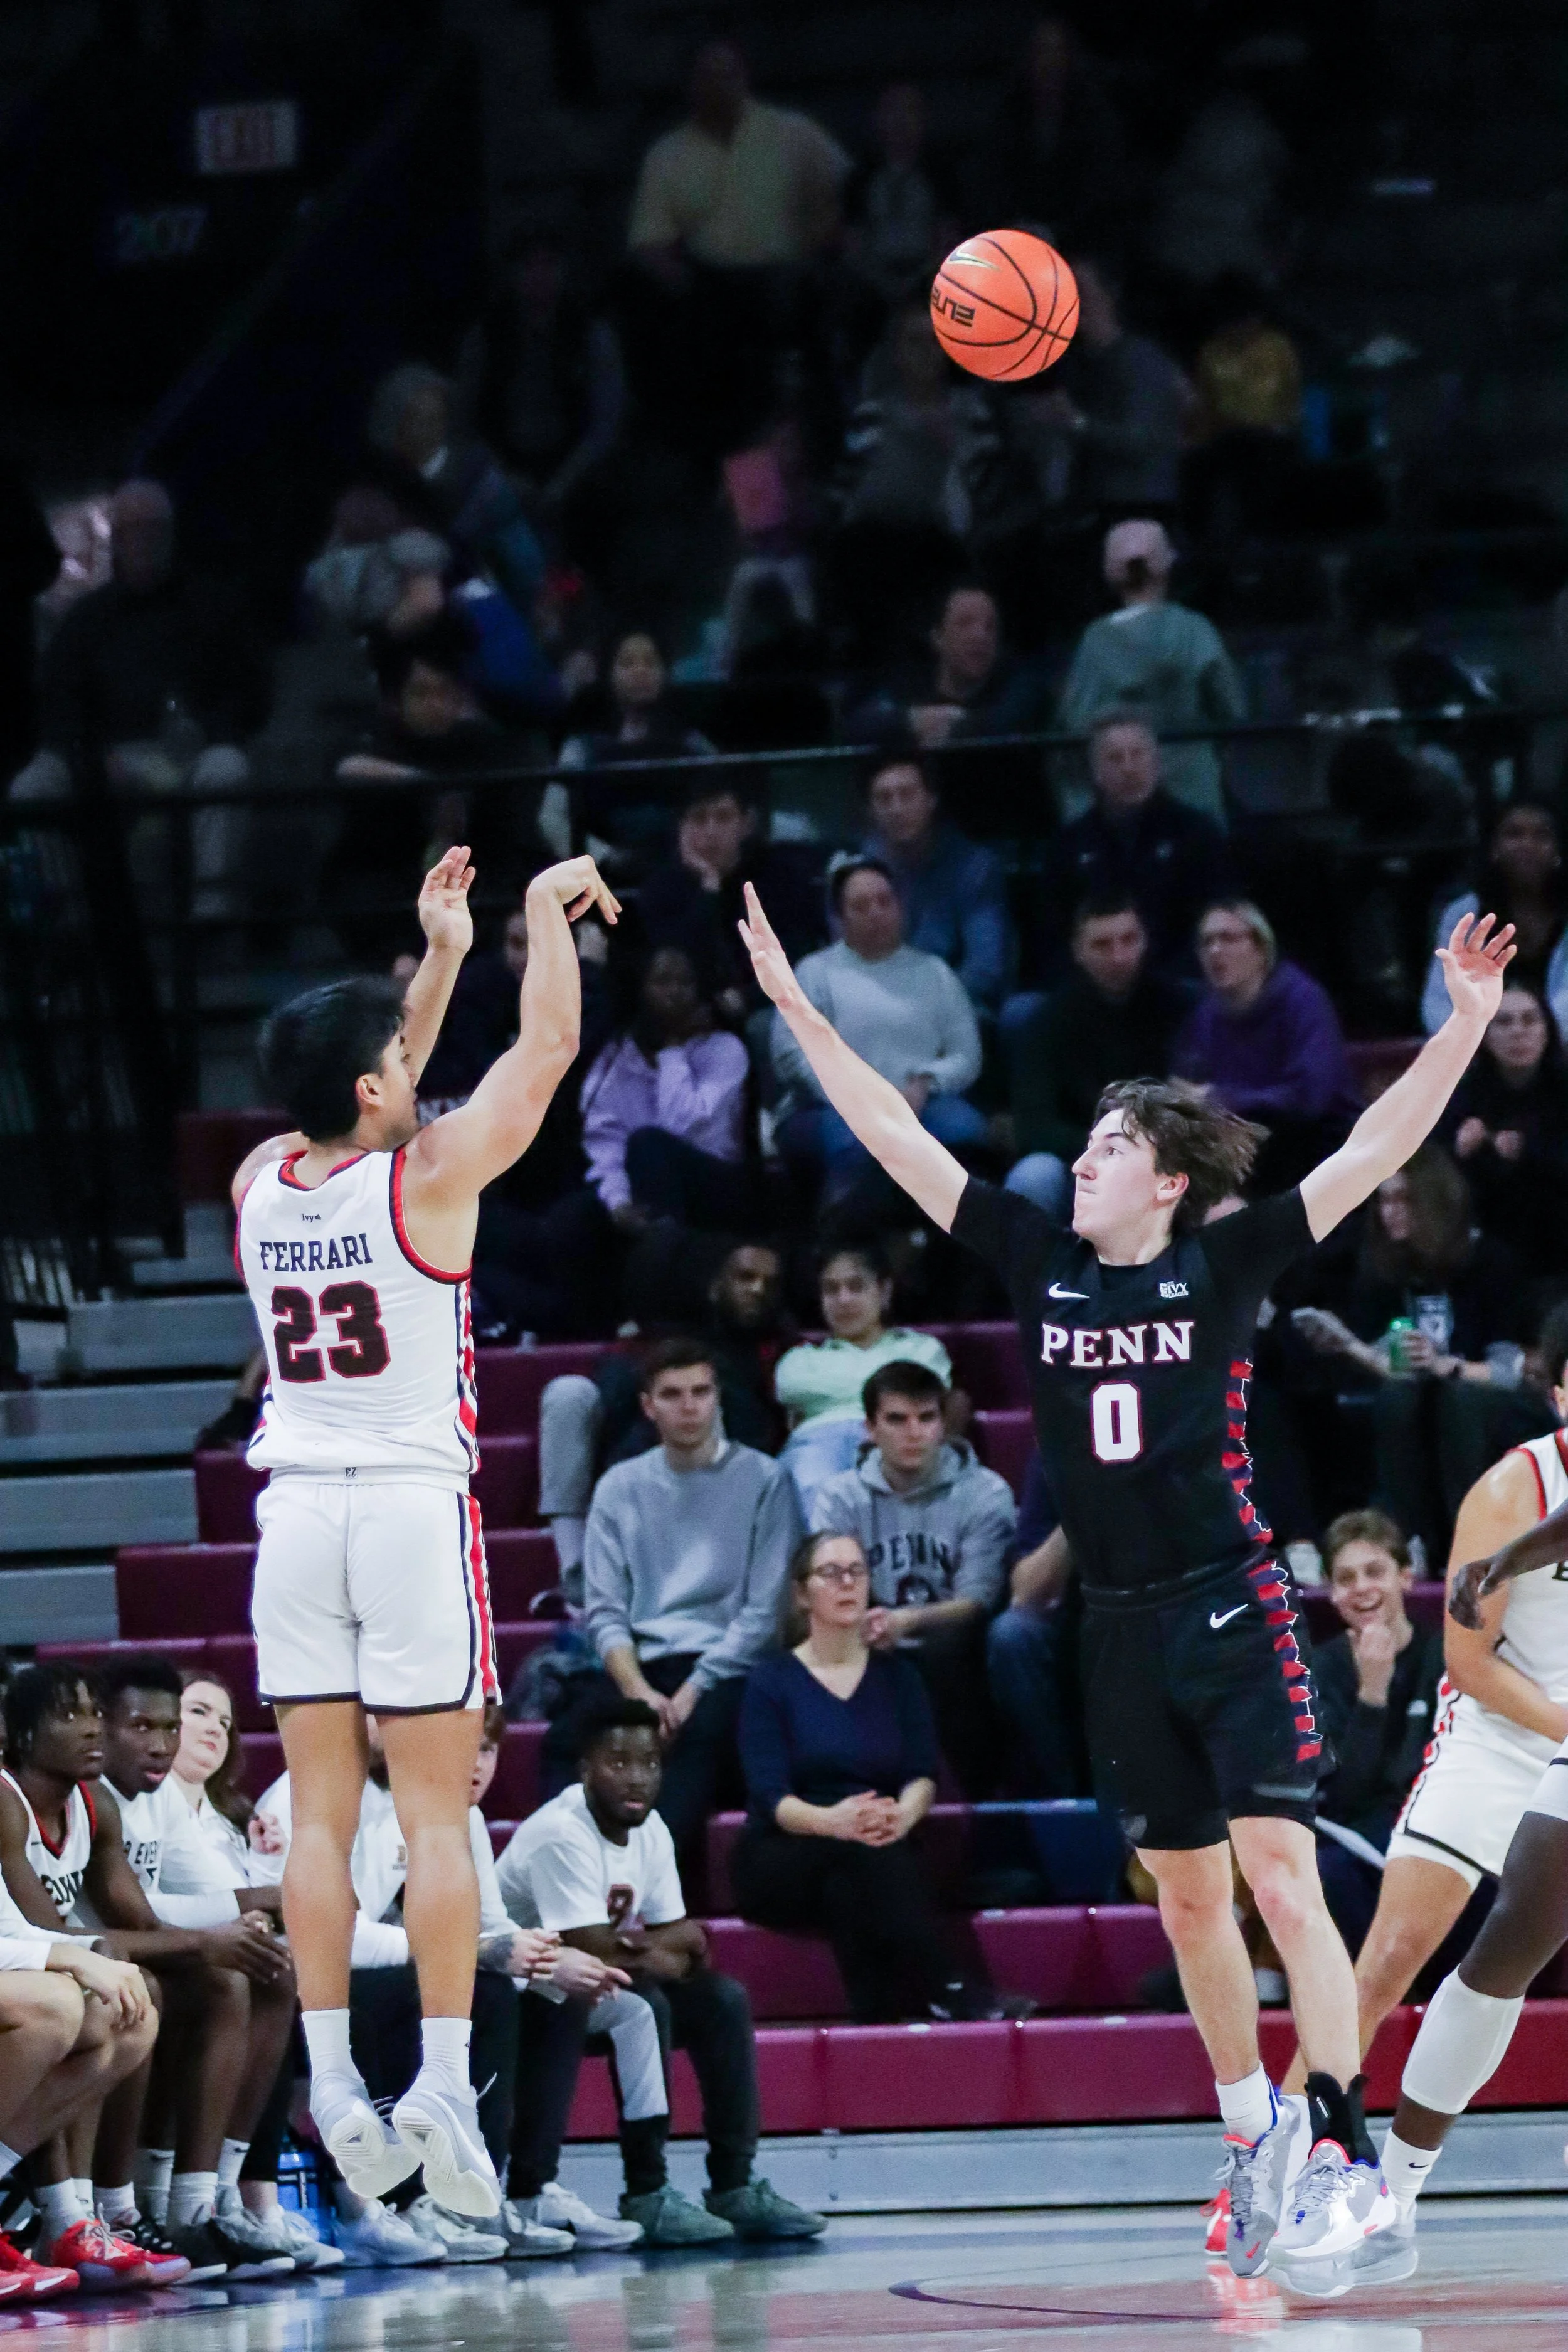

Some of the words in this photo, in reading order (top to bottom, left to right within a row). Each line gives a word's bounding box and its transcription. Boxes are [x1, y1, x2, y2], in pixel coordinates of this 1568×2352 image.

[259, 1232, 373, 1272] FERRARI
[271, 1280, 391, 1384] 23
[1040, 1320, 1194, 1369] PENN
[1090, 1380, 1143, 1465] 0
